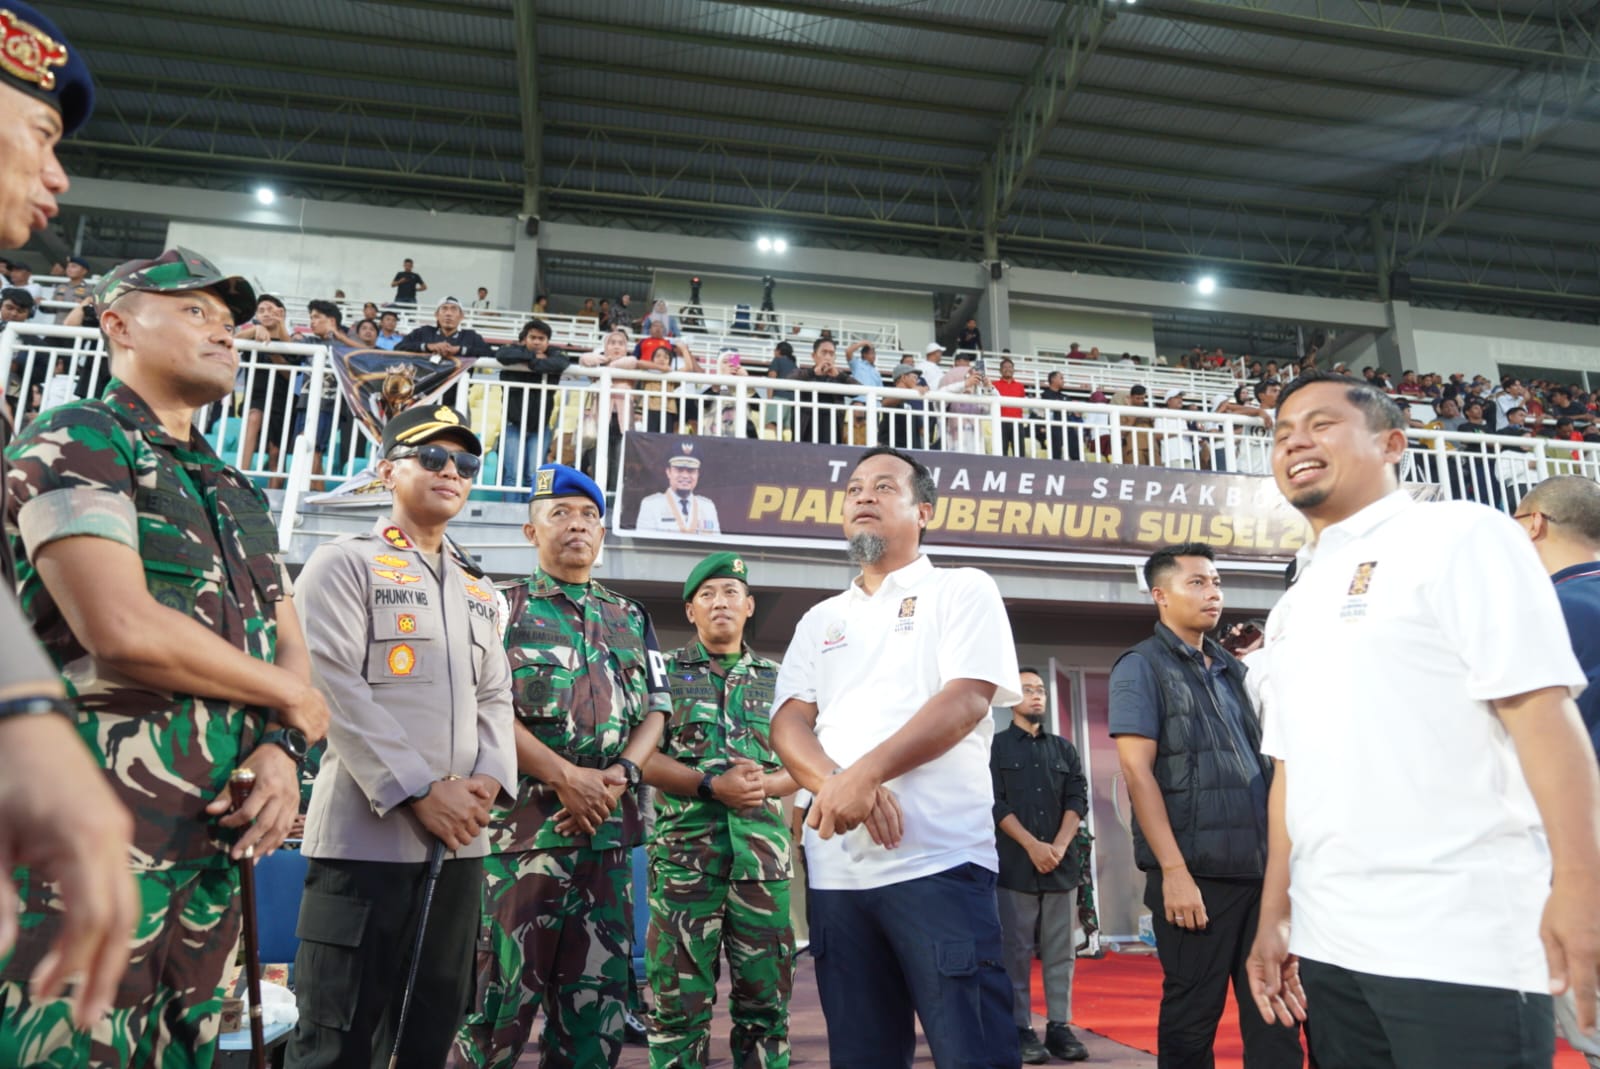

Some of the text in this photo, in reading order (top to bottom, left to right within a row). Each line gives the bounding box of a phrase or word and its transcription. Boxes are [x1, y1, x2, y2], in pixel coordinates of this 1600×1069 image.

[828, 460, 1268, 508] TNAMEN SEPAKB
[747, 485, 846, 526] PIAL
[926, 496, 1121, 540] UBERNUR
[1137, 510, 1276, 549] SULSEL
[375, 588, 414, 605] PHUNKY
[467, 599, 496, 625] POLR
